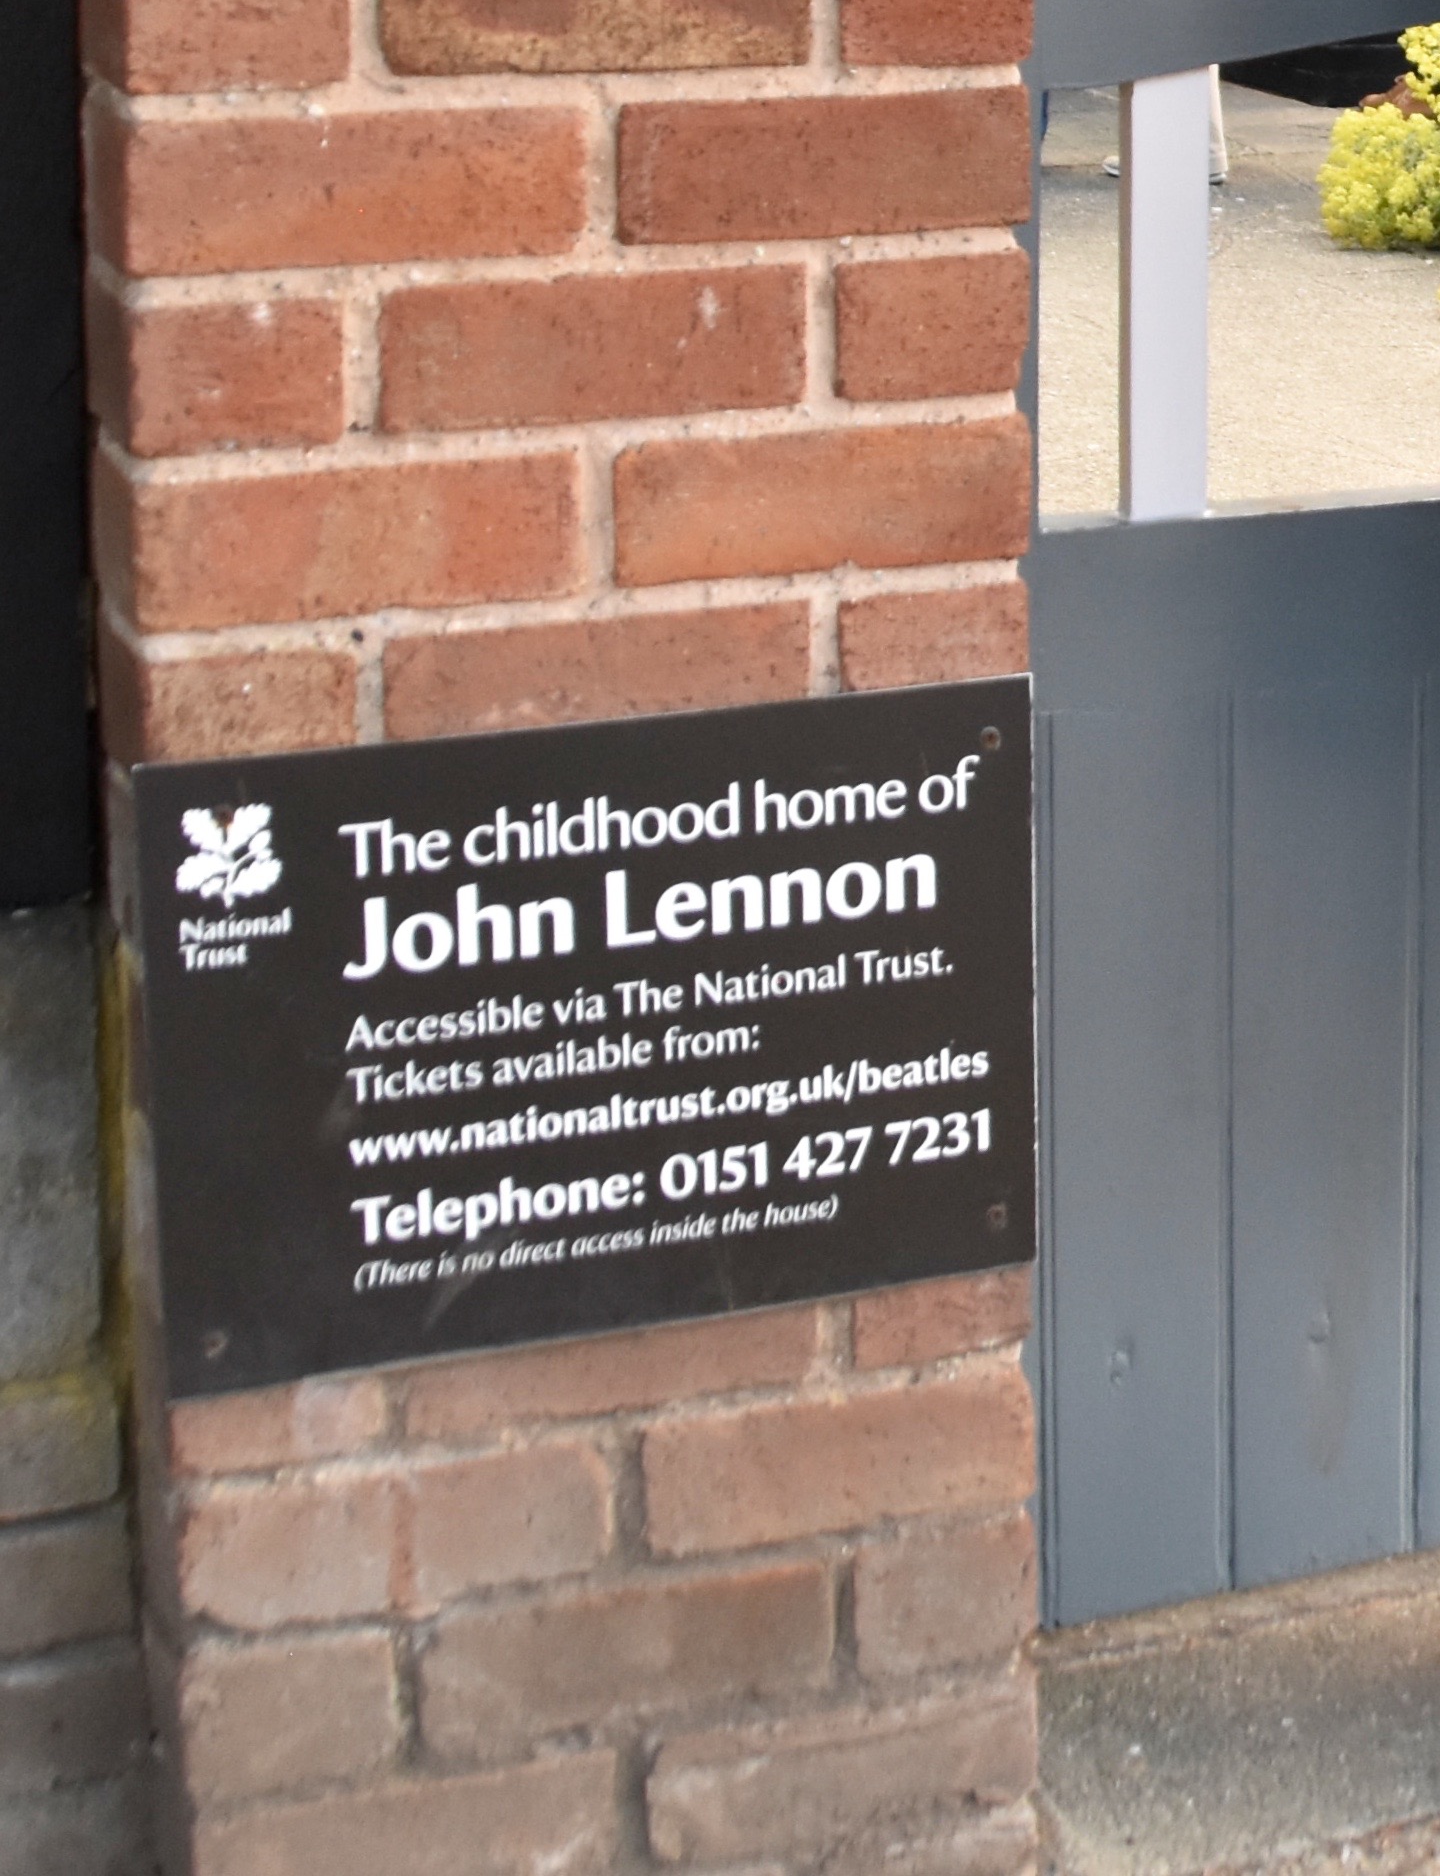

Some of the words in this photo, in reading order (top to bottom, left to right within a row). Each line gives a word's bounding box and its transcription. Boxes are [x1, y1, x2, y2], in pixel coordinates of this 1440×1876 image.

[338, 818, 451, 879] The
[463, 781, 741, 866] childhood
[754, 778, 907, 834] home
[918, 754, 980, 814] of
[179, 907, 292, 943] National
[180, 942, 248, 970] Trust
[342, 883, 575, 980] John
[605, 853, 937, 949] Lennon
[345, 995, 545, 1052] Accessible
[552, 987, 607, 1025] via
[613, 979, 684, 1017] The
[694, 953, 846, 1007] National
[854, 947, 953, 985] Trust.
[346, 1060, 484, 1104] Tickets
[492, 1032, 653, 1086] available
[662, 1025, 760, 1062] from:
[348, 1047, 989, 1166] www.nationaltrust.org.uk/beatles
[350, 1171, 645, 1245] Telephone:
[660, 1141, 768, 1200] 0151
[782, 1125, 873, 1181] 427
[884, 1108, 991, 1166] 7231
[354, 1259, 432, 1291] (There
[437, 1251, 457, 1277] is
[461, 1251, 495, 1273] no
[499, 1238, 566, 1268] direct
[571, 1228, 644, 1257] access
[649, 1213, 717, 1245] inside
[721, 1207, 759, 1235] the
[763, 1194, 839, 1227] house)
